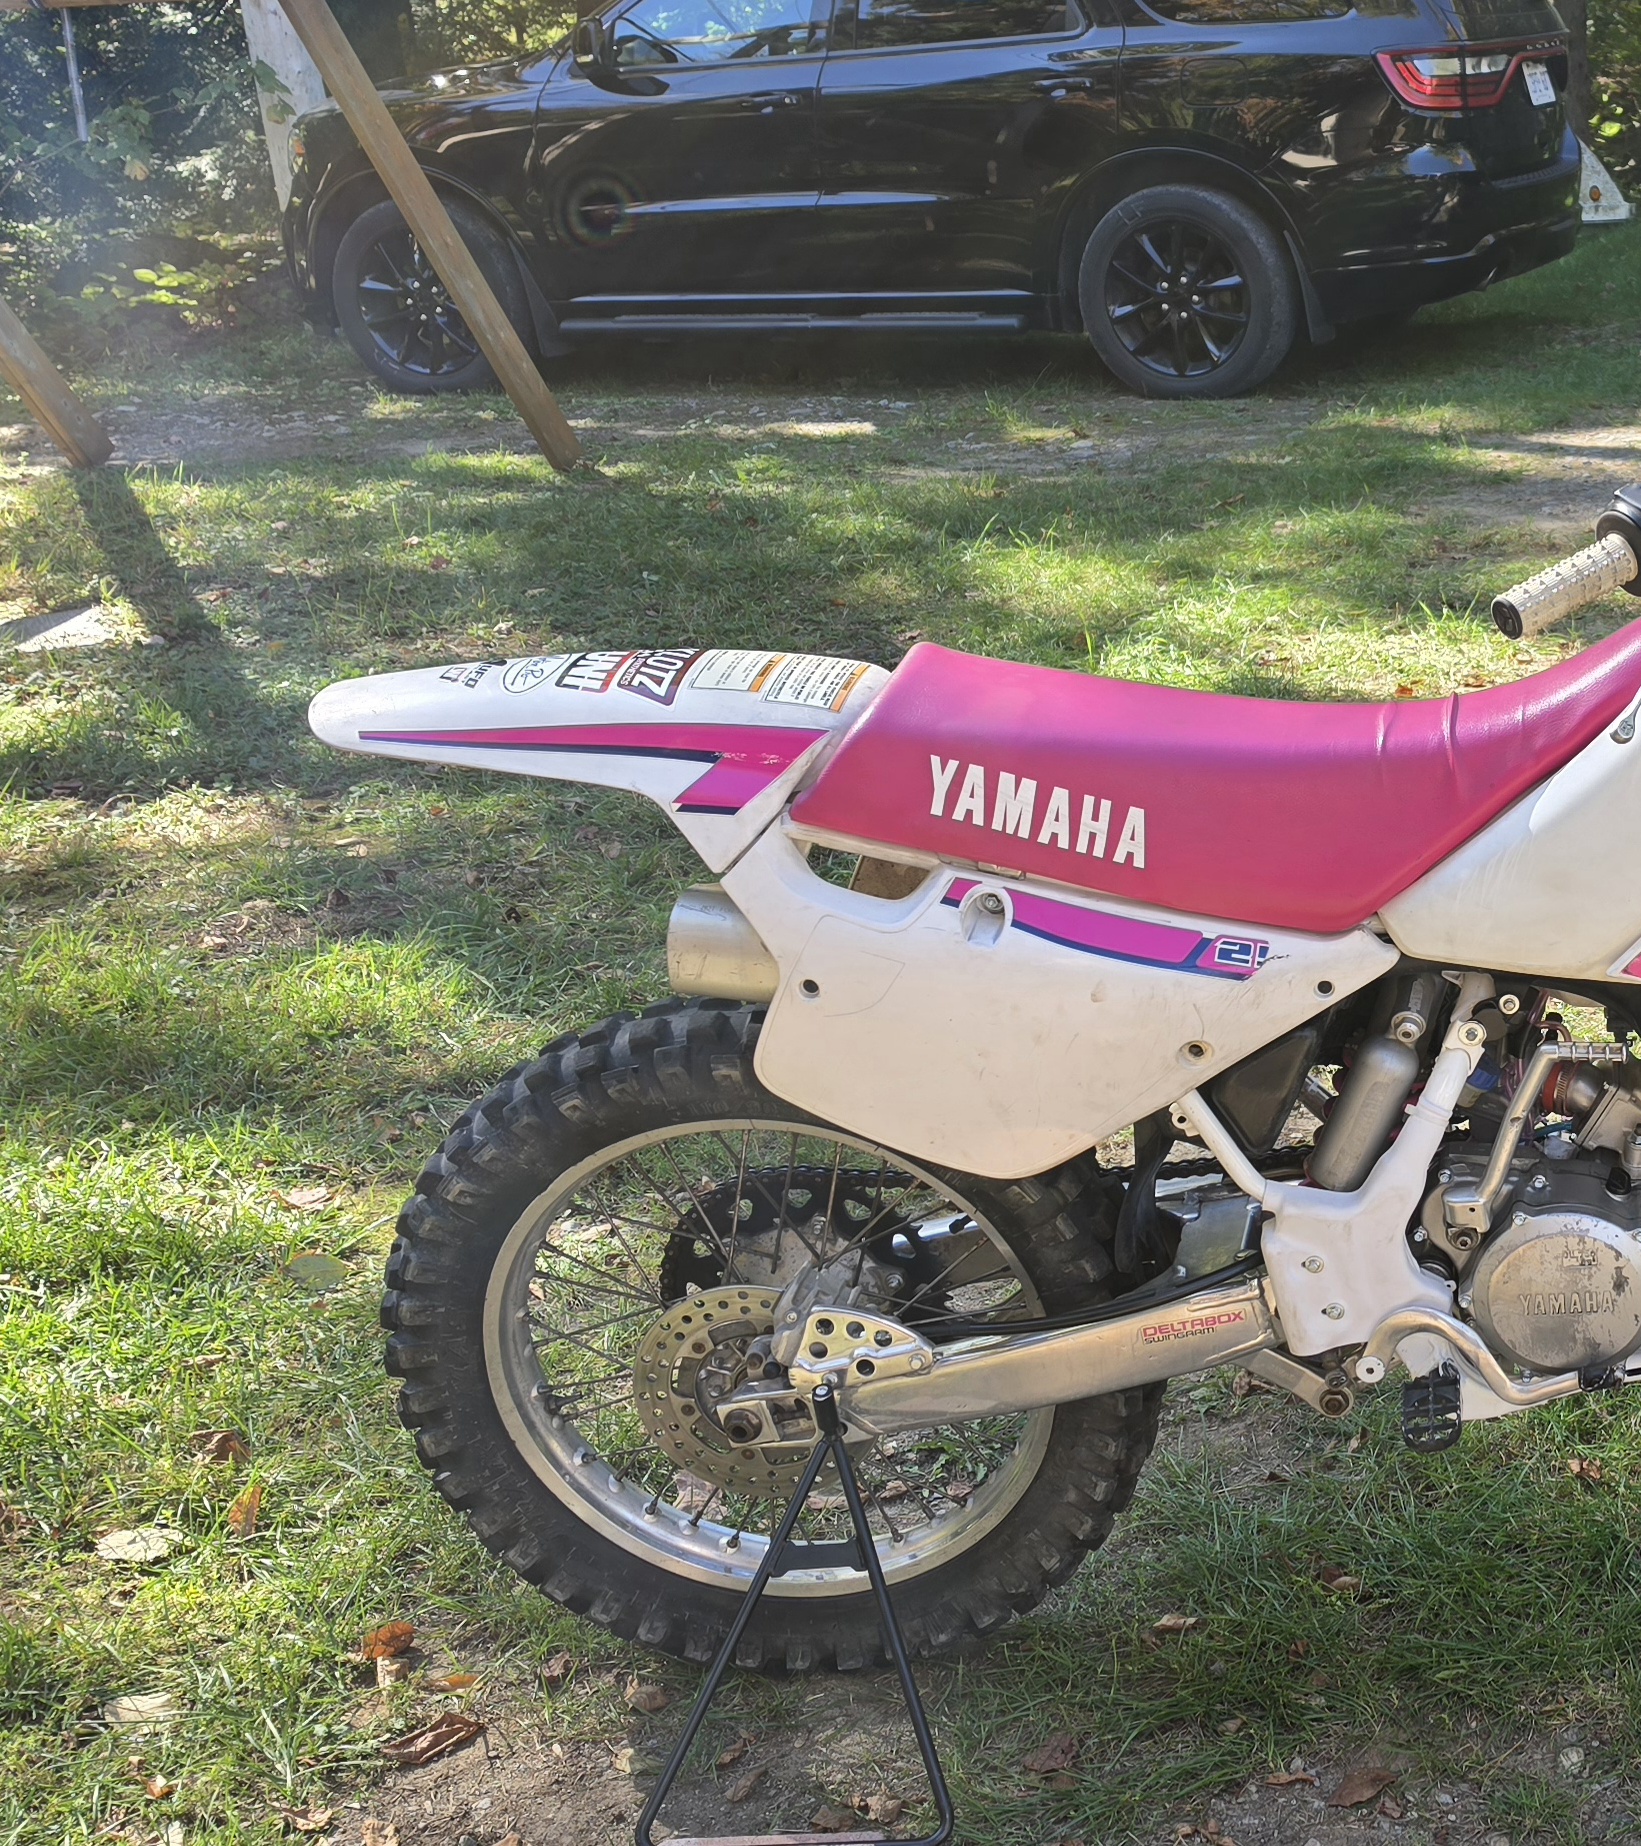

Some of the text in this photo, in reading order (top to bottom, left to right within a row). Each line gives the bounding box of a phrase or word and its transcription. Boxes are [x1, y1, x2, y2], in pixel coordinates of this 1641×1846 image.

[930, 754, 1145, 869] YAMAHA
[1519, 1290, 1616, 1317] YAMAHA
[1142, 1310, 1245, 1338] DELTABOX
[1144, 1326, 1216, 1345] SWINGARM
